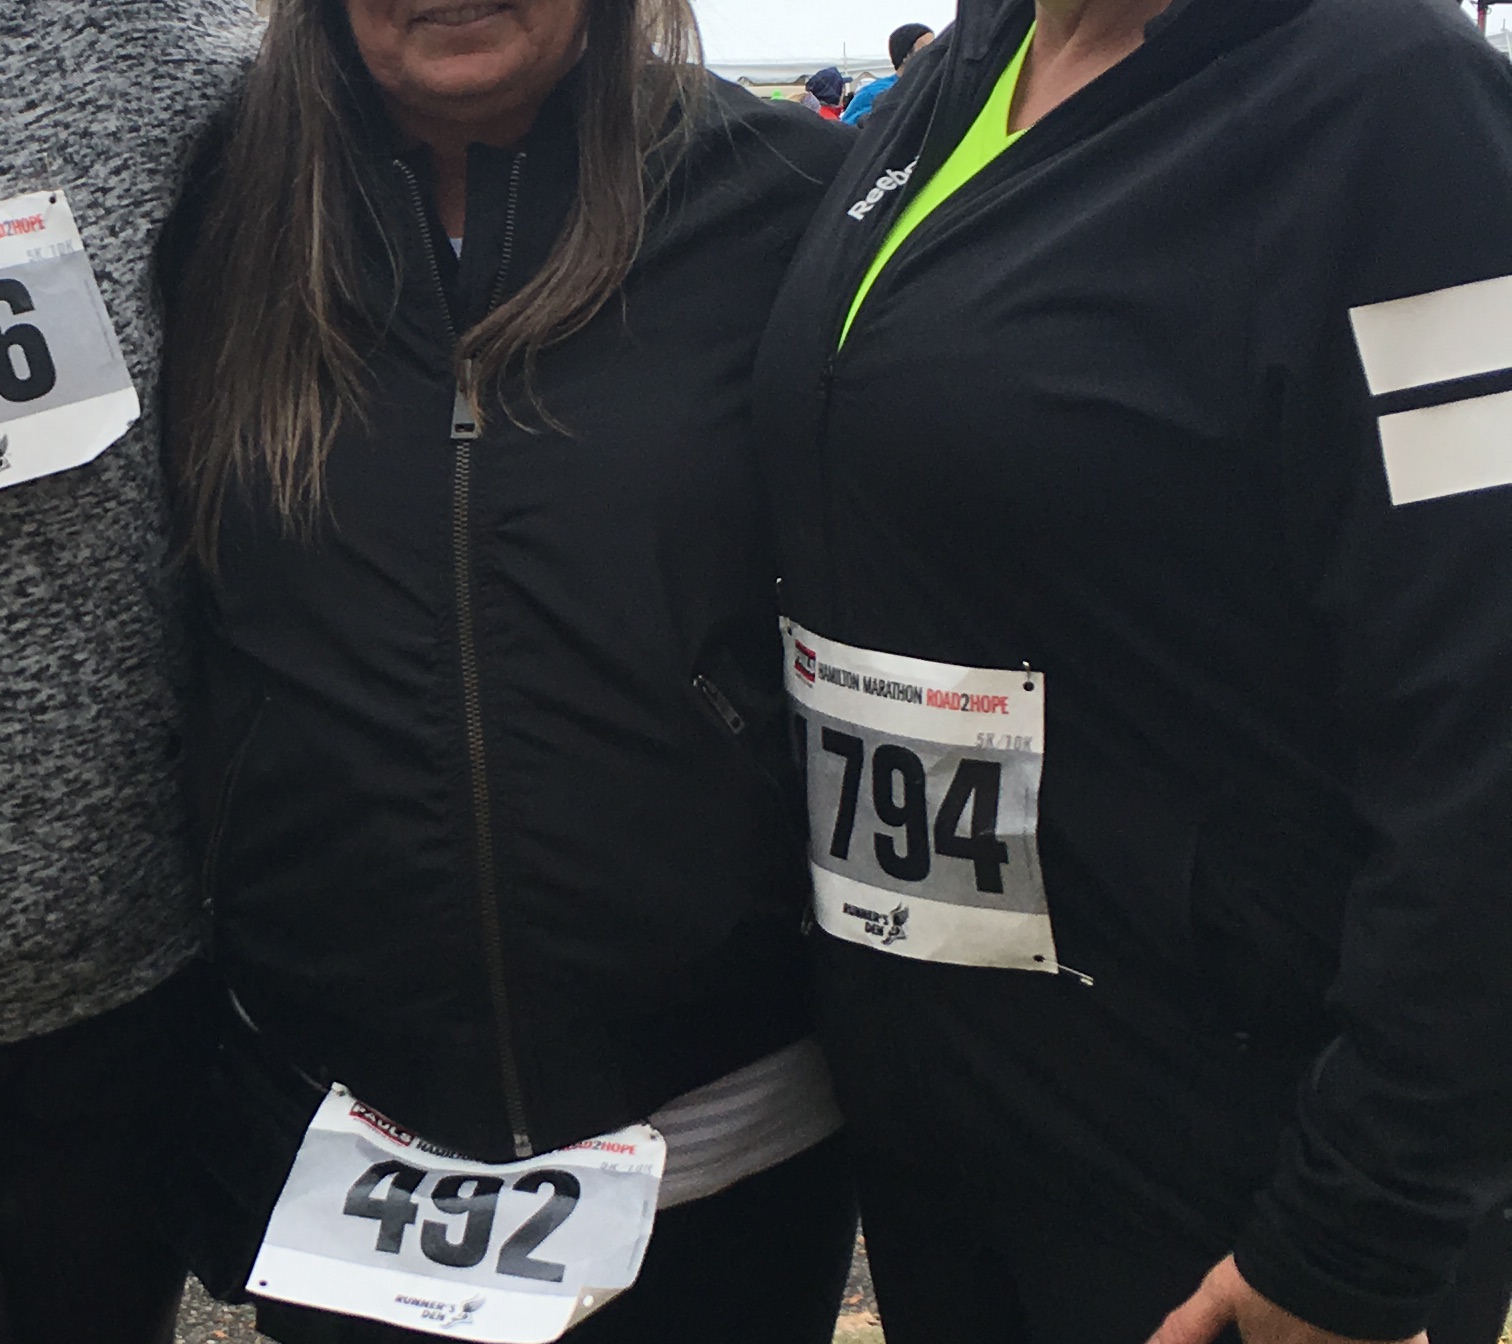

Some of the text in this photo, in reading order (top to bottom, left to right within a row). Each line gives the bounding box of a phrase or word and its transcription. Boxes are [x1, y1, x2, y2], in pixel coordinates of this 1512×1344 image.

[863, 675, 923, 705] MARATHON
[926, 687, 1009, 715] ROAD2HOPE
[351, 1104, 413, 1144] PAULS
[343, 1160, 581, 1284] 492
